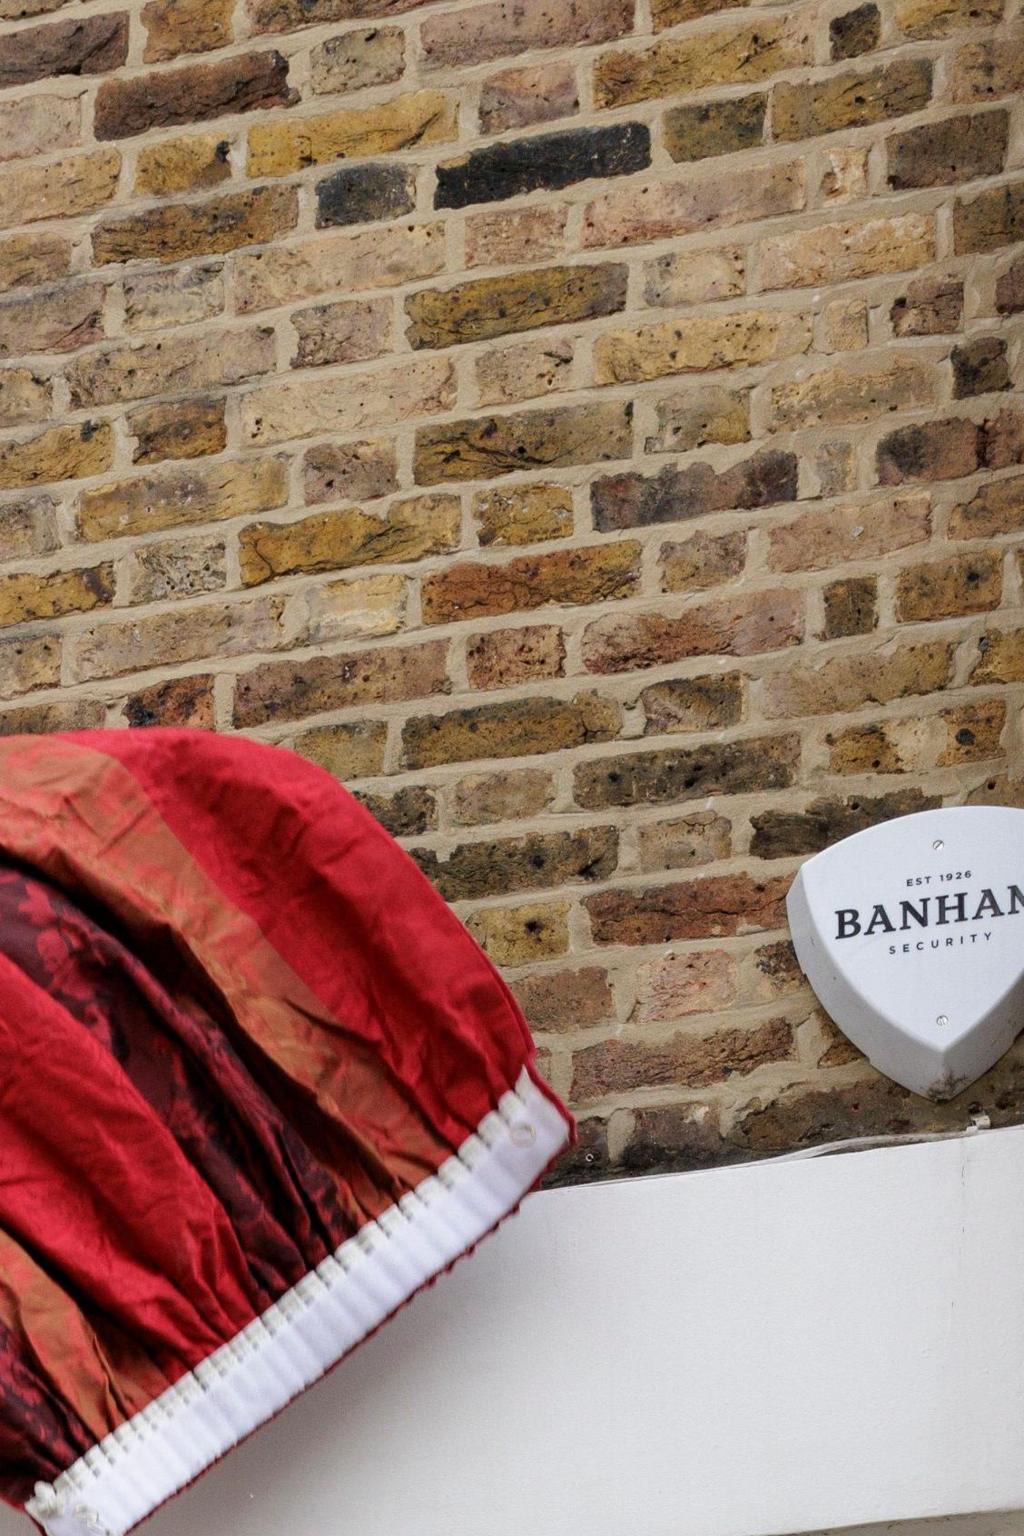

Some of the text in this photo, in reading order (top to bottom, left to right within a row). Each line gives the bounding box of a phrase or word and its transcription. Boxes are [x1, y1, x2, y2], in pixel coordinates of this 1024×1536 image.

[906, 870, 973, 887] EST 1926
[889, 931, 992, 955] SECURITY
